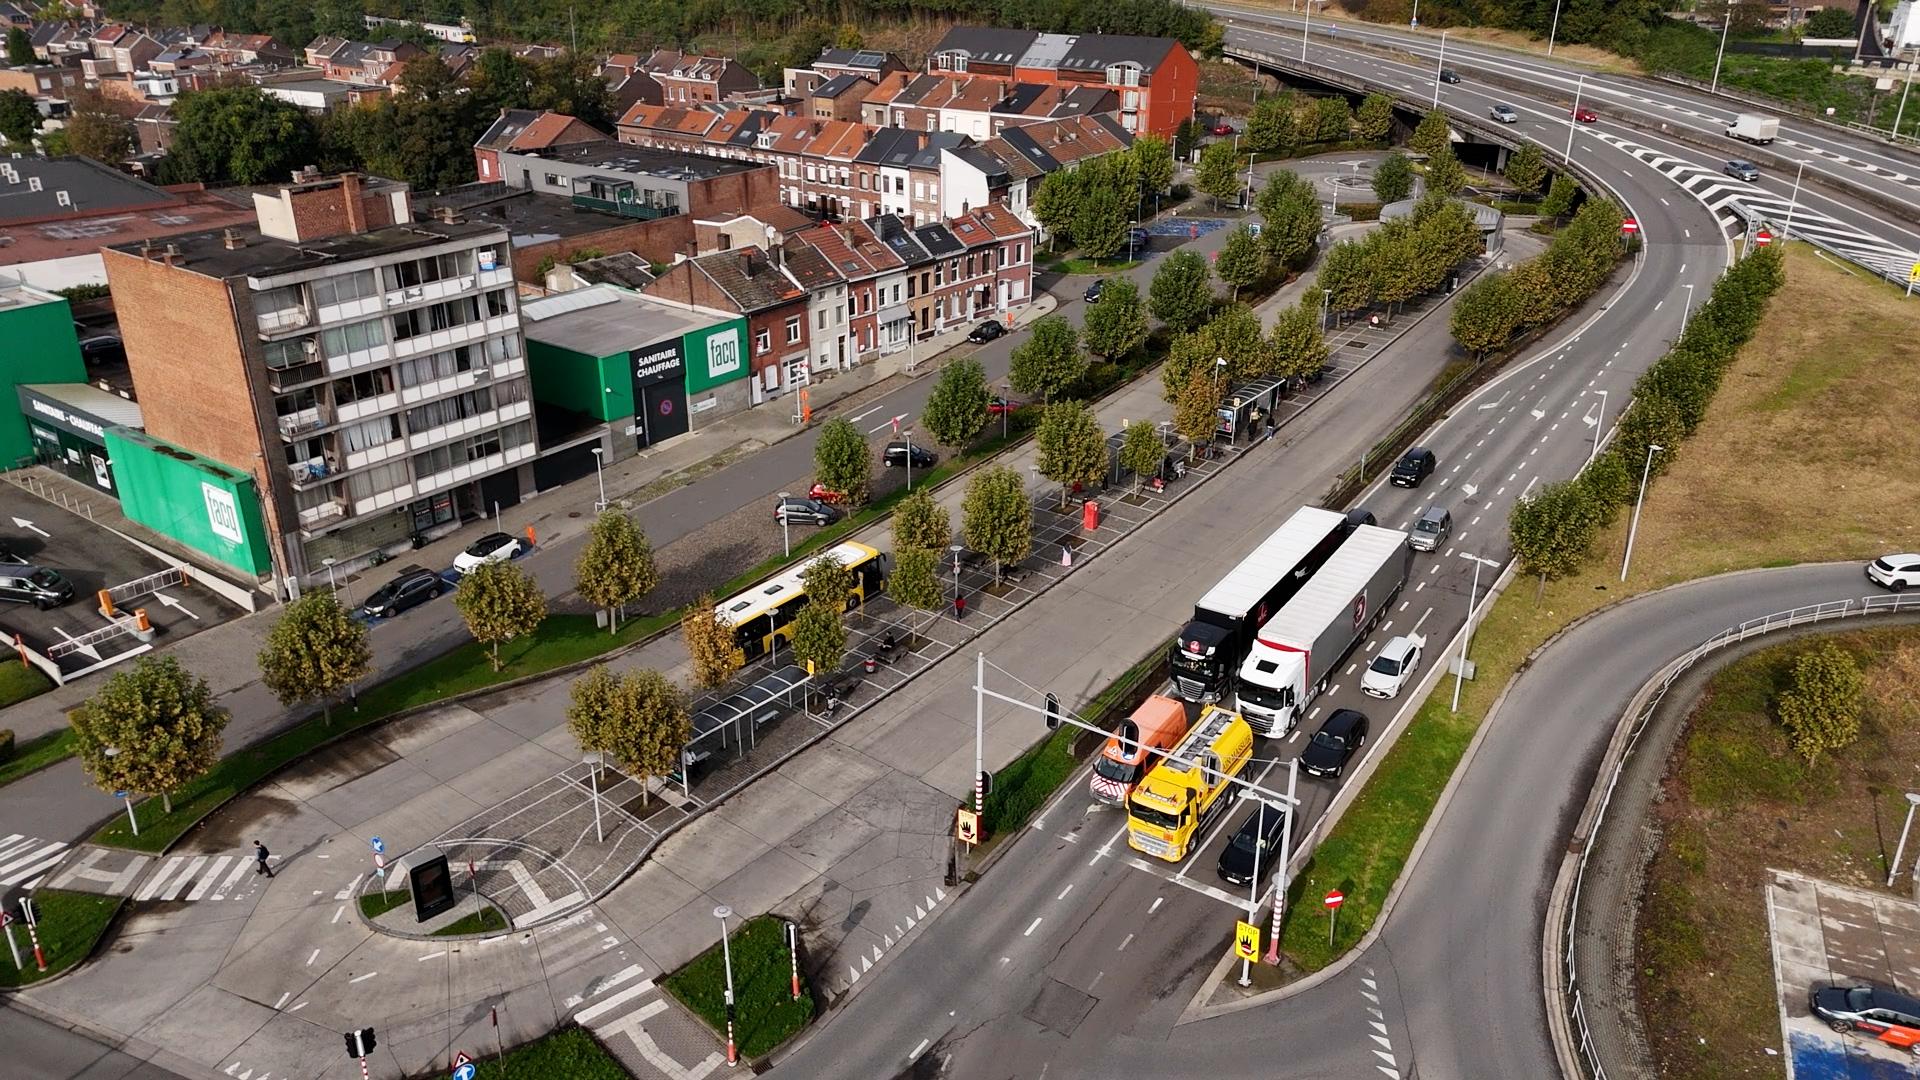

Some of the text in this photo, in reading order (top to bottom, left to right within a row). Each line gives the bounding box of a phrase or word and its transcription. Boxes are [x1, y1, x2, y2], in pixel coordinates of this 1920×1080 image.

[638, 348, 677, 367] SANITAIRE
[710, 339, 736, 368] facq
[636, 358, 681, 378] CHAUFFAGE
[206, 488, 239, 537] facq
[1238, 923, 1258, 935] STOP
